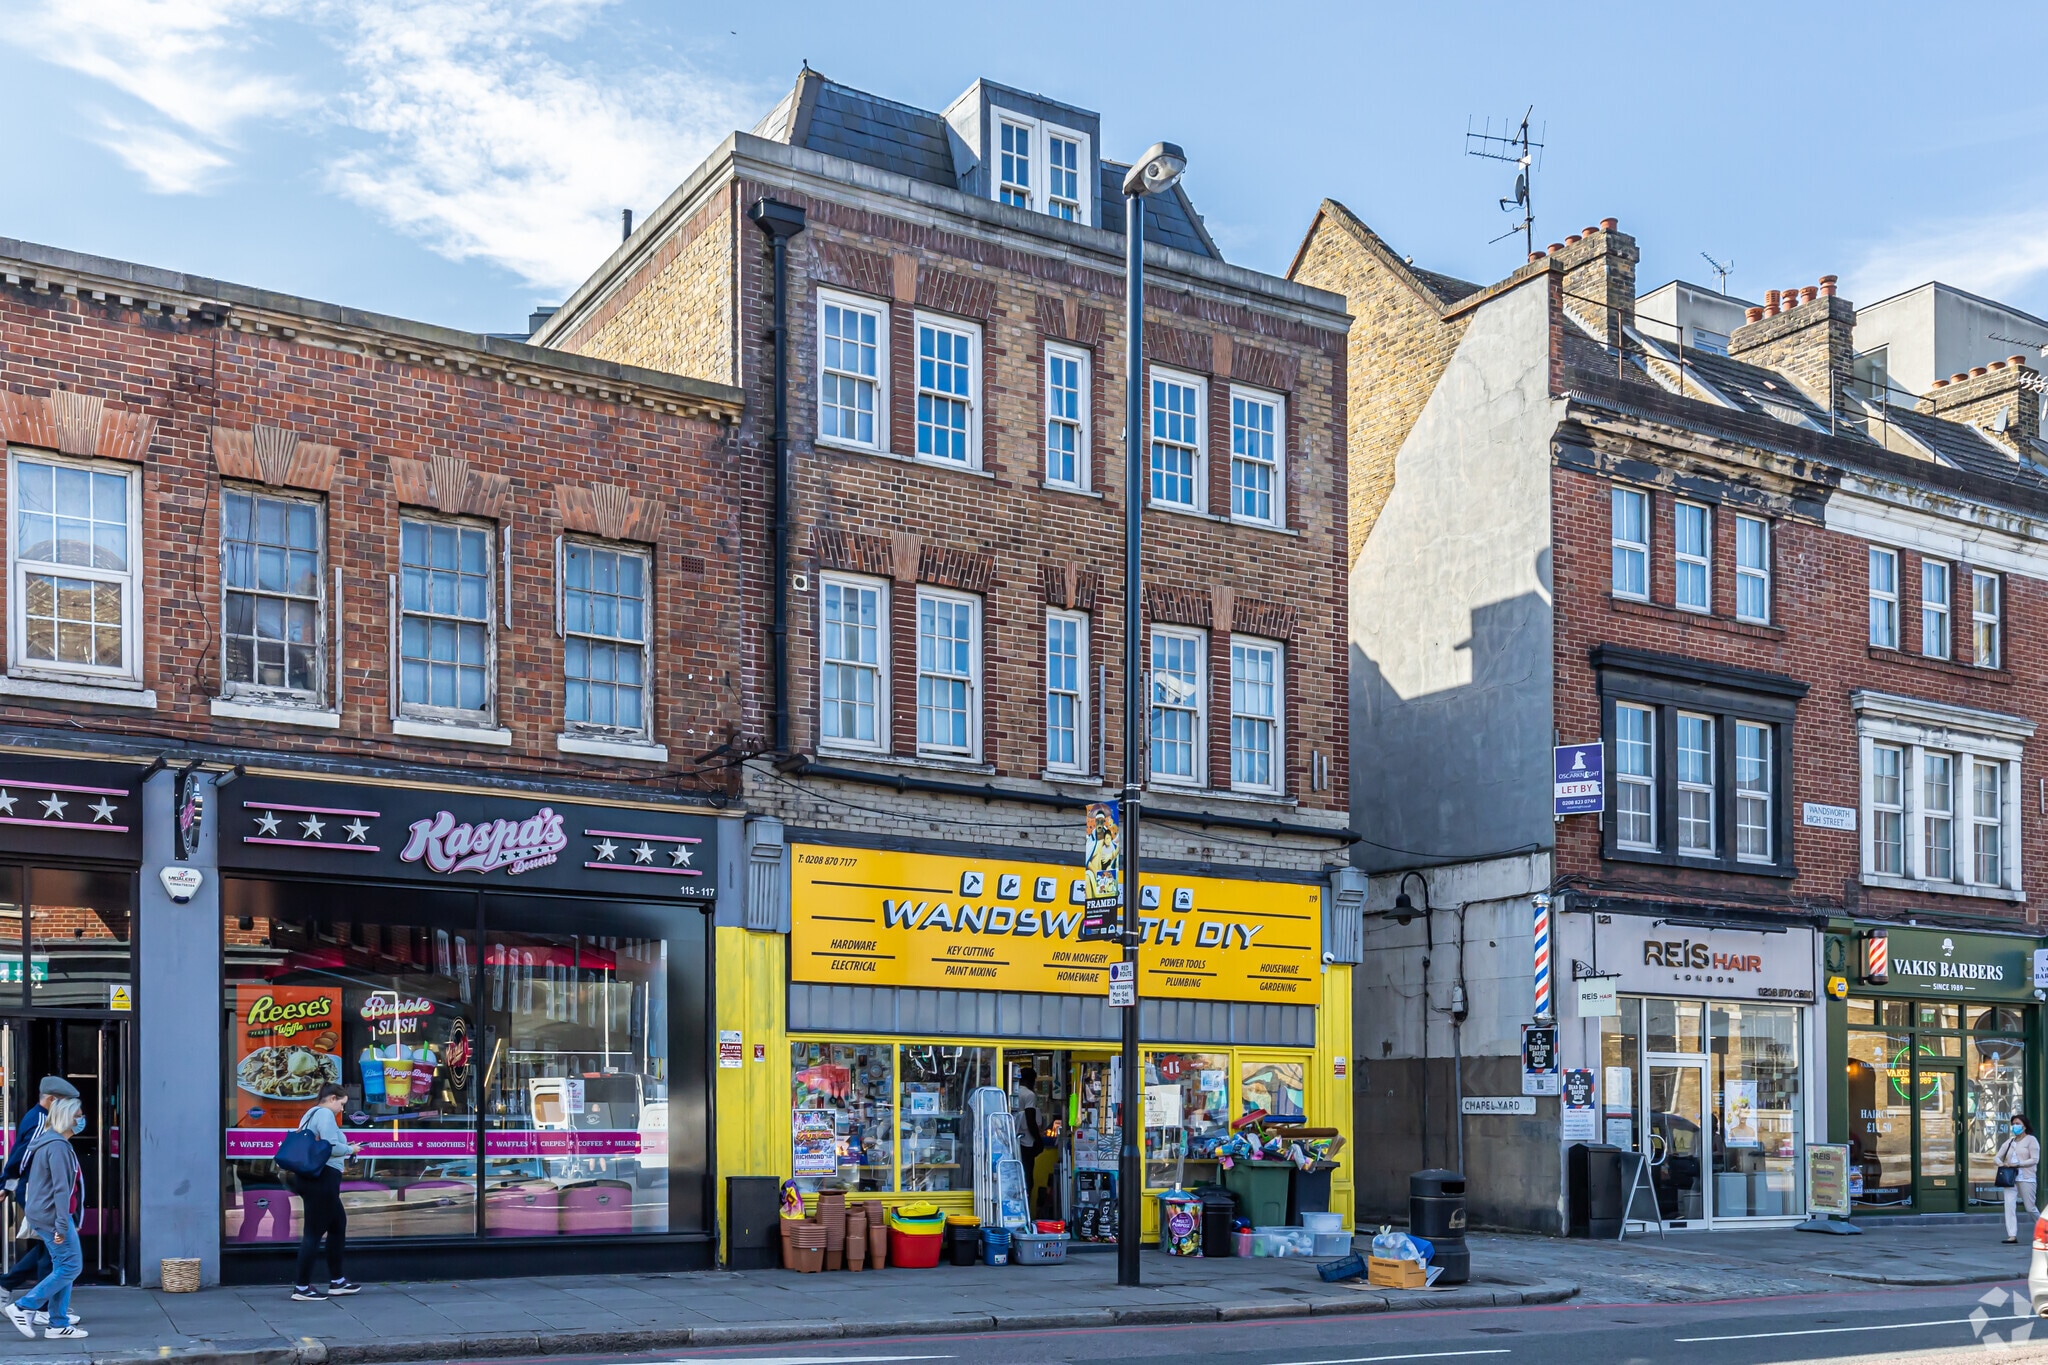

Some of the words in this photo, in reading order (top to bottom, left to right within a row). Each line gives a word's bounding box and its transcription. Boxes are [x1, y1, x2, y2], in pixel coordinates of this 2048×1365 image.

[1561, 785, 1578, 794] LET
[1580, 784, 1592, 793] BY
[1809, 806, 1850, 818] WANDSWORTH
[1806, 815, 1821, 824] HIGH
[1823, 817, 1844, 827] STREET
[400, 807, 567, 874] Kaspa's
[508, 854, 557, 875] Desserts
[798, 854, 804, 864] T:
[805, 855, 824, 865] 0208
[824, 856, 838, 866] 870
[840, 858, 858, 867] 7177
[680, 886, 694, 895] 115
[701, 888, 714, 896] 117
[1086, 898, 1117, 909] FRAMED
[1308, 895, 1318, 903] 119
[882, 899, 1185, 946] WANDSWTH
[1194, 921, 1264, 950] DIY
[1598, 915, 1612, 924] 121
[830, 939, 878, 951] HARDWARE
[946, 946, 962, 956] KEY
[962, 946, 995, 958] CUTTING
[1052, 951, 1071, 962] IRON
[1072, 952, 1108, 964] MONGERY
[831, 960, 876, 972] ELECTRICAL
[1160, 957, 1184, 968] POWER
[1185, 958, 1206, 970] TOOLS
[1260, 963, 1300, 974] HOUSEWARE
[1713, 952, 1762, 973] HAIR
[945, 966, 969, 976] PAINT
[968, 967, 998, 978] MIXING
[1894, 958, 1937, 976] VAKIS
[1940, 962, 2004, 980] BARBERS
[1056, 971, 1099, 982] HOMEWARE
[1165, 976, 1202, 988] PLUMBING
[1674, 973, 1735, 984] LONDON
[1260, 981, 1297, 992] GARDENING
[1932, 983, 1950, 991] SINCE
[247, 995, 332, 1026] Reese's
[361, 997, 432, 1019] Bubble
[274, 1022, 304, 1038] Waffle
[378, 1018, 418, 1036] SLUSH
[385, 1068, 411, 1079] Mango
[412, 1069, 432, 1082] Berry
[1886, 1069, 1910, 1077] VAKIS
[1464, 1101, 1496, 1110] CHAPEL
[1498, 1101, 1520, 1110] YARD
[1860, 1110, 1896, 1118] HAIRCUT
